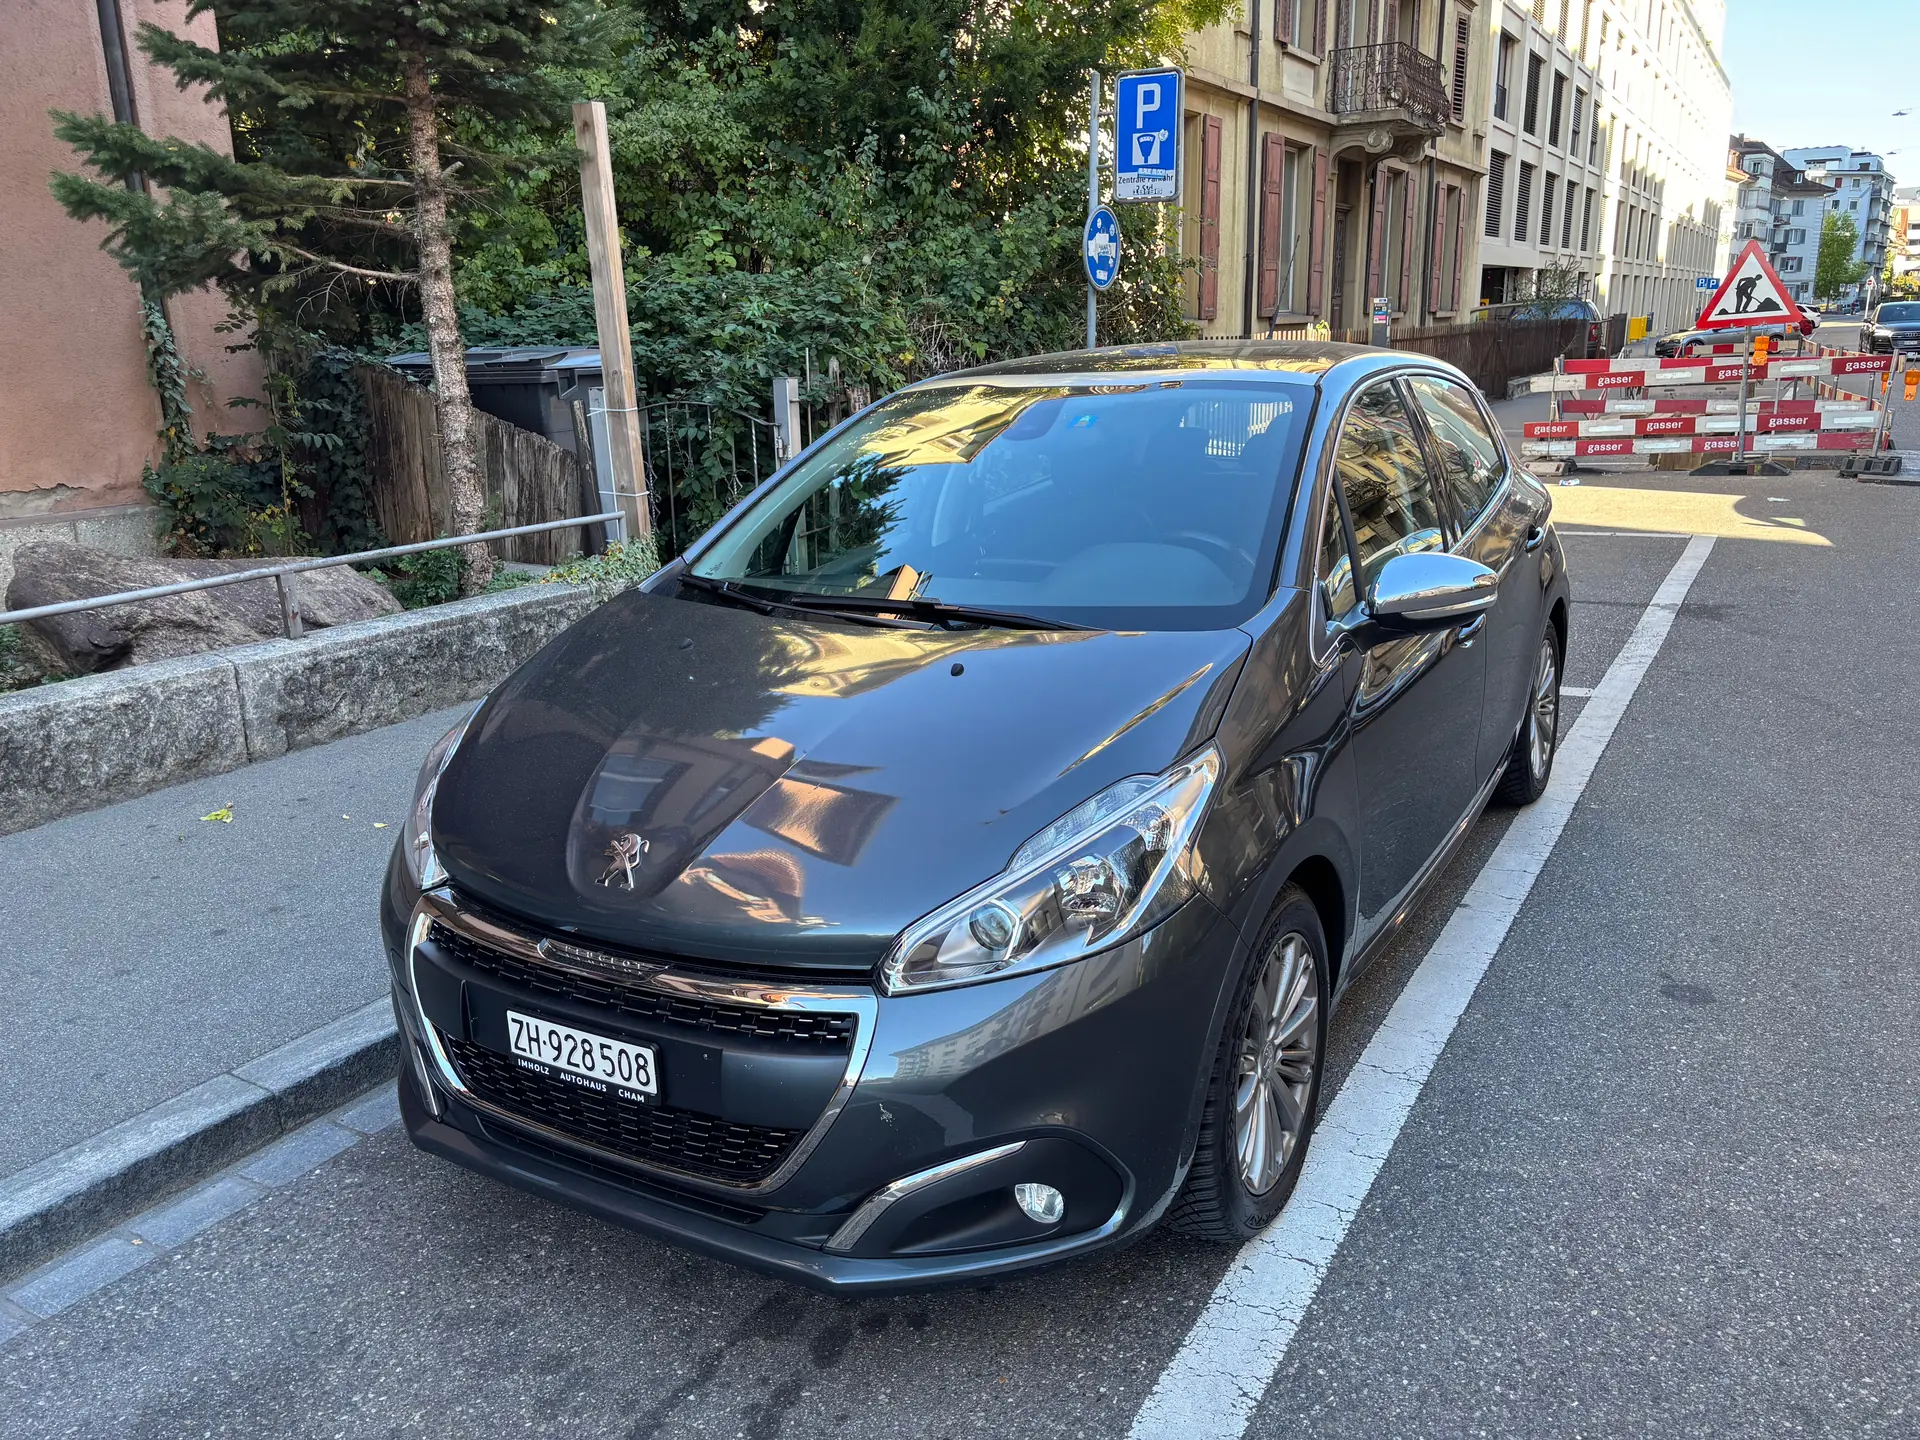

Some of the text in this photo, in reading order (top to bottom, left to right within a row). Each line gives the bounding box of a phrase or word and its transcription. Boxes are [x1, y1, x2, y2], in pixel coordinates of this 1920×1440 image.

[1136, 83, 1161, 129] P
[1118, 176, 1145, 184] Zentrale
[1710, 279, 1716, 288] P
[1597, 375, 1634, 387] gasser
[1845, 360, 1887, 371] gasser
[1533, 416, 1808, 435] gasser gasser gasser
[1587, 443, 1622, 453] gasser
[517, 1058, 645, 1103] IMHOLZ AUTOHAUS CHAM
